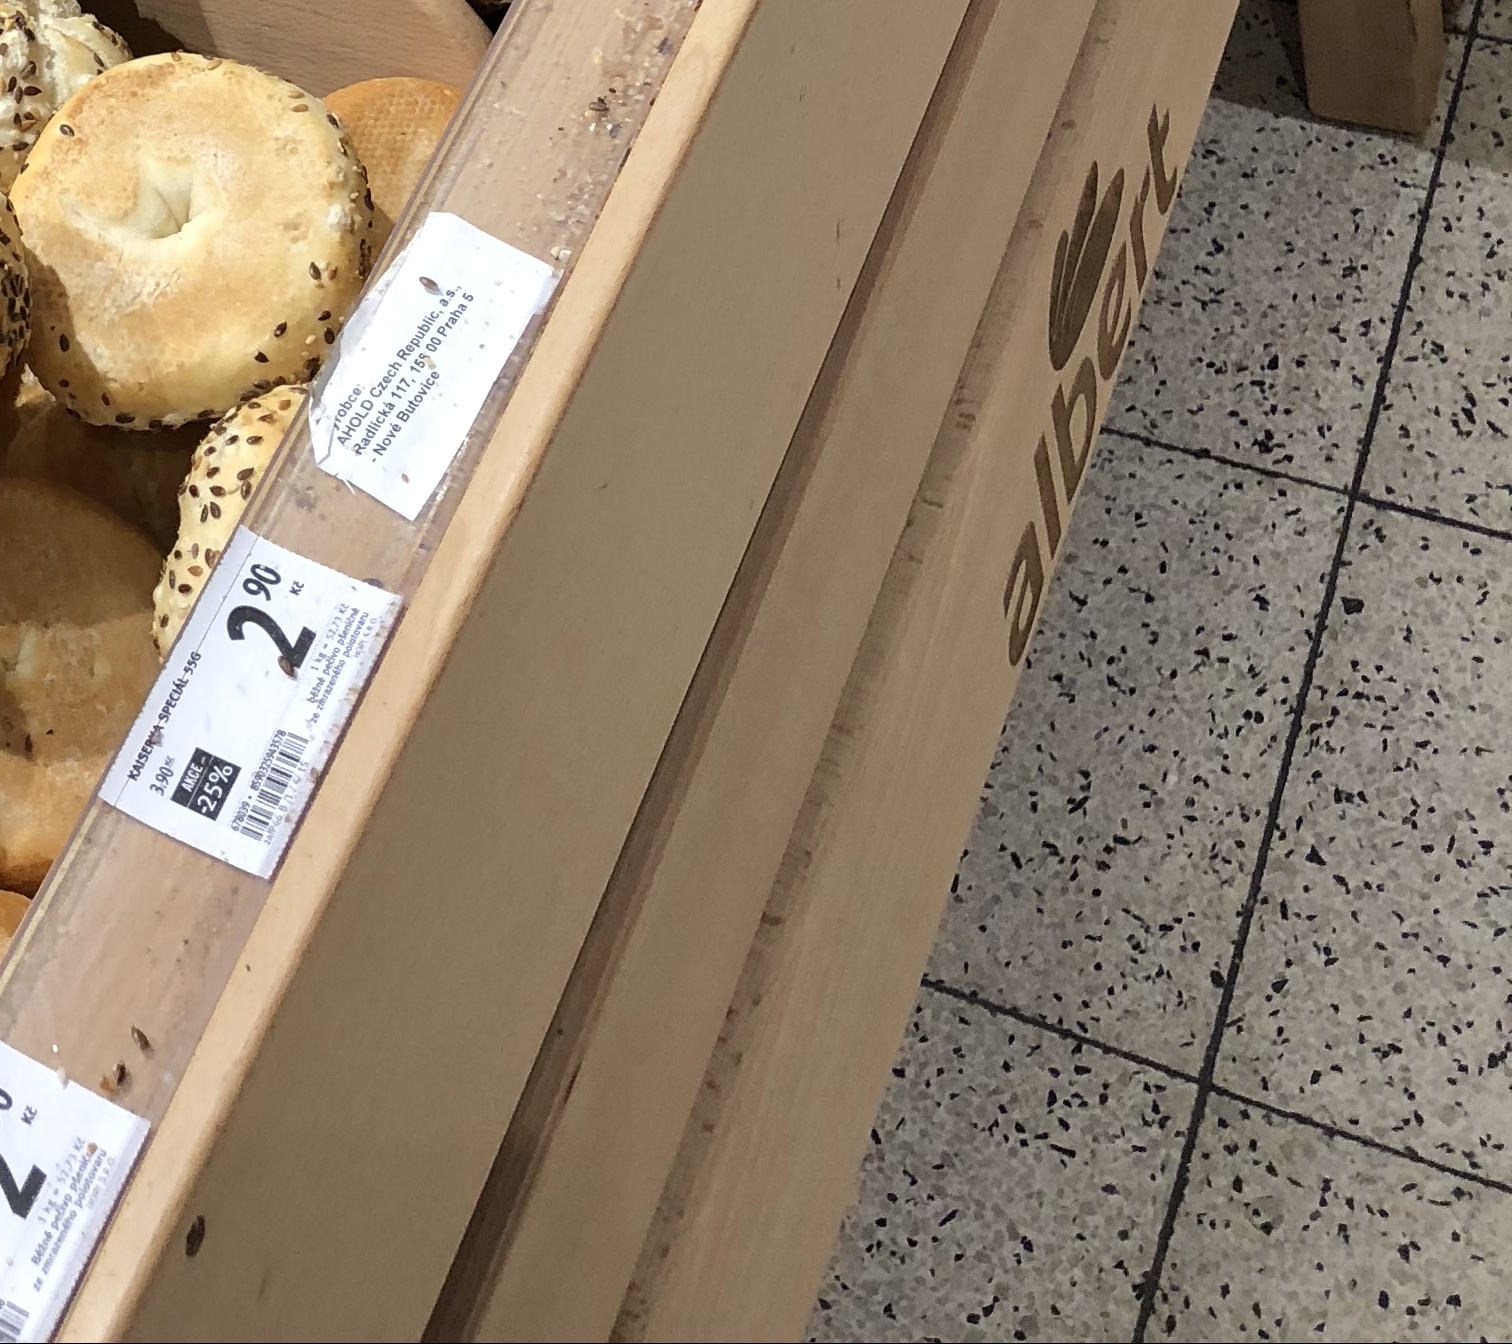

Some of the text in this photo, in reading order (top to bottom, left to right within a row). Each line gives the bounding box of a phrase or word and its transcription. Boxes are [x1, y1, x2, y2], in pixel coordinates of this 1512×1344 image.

[336, 285, 462, 447] AHOLD Czech Republic, a.s.,
[351, 401, 396, 455] Radlická
[390, 377, 416, 399] 117,
[425, 336, 442, 352] 00
[436, 303, 468, 337] Praha
[461, 292, 474, 302] 5
[372, 422, 402, 456] Nové
[395, 366, 440, 423] Butovice
[1003, 103, 1178, 668] albert
[226, 563, 317, 669] 2 90 Kč
[306, 607, 360, 704] běžné pečivo pšeničné
[313, 651, 327, 663] kg
[127, 651, 201, 781] KAISERKA SPECIÁL 55G
[309, 611, 369, 724] ze zmrazeného polotovaru
[181, 762, 203, 792] AKCE
[197, 765, 233, 813] -25%
[230, 729, 287, 832] 678039 8590325943578
[20, 1105, 38, 1125] Kč
[50, 1193, 73, 1230] pečivo
[69, 1148, 109, 1209] polotovaru
